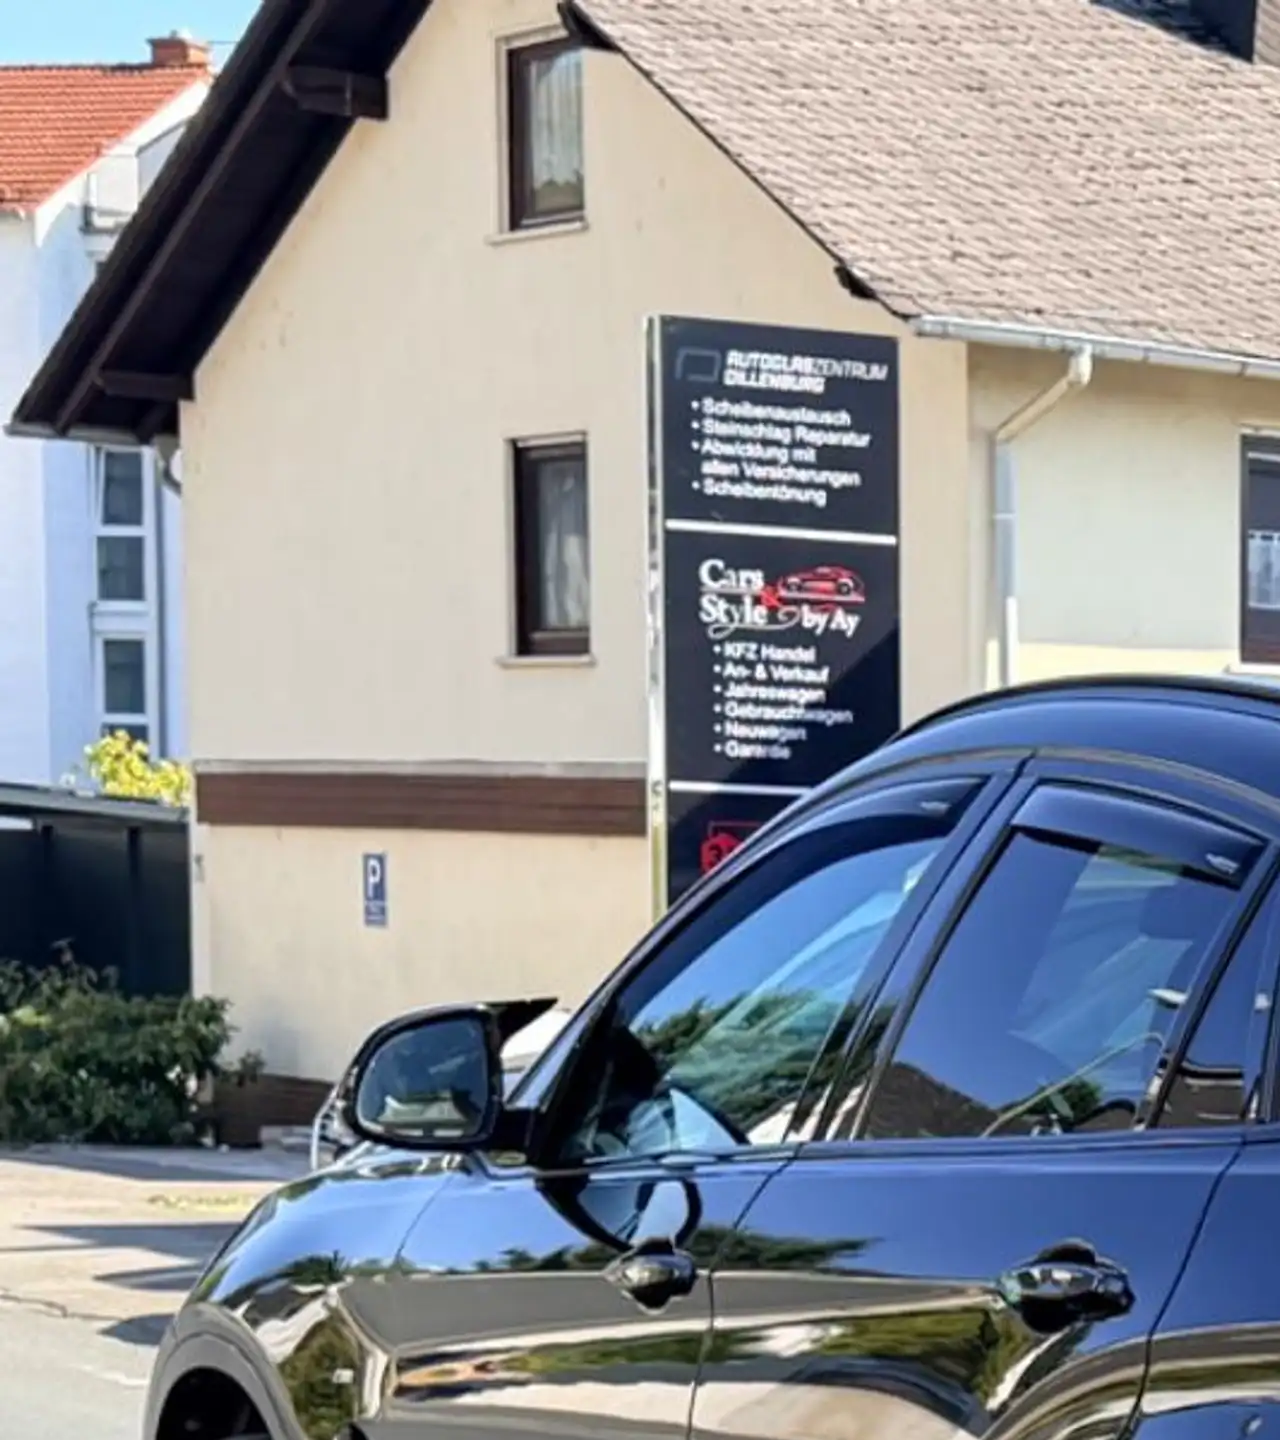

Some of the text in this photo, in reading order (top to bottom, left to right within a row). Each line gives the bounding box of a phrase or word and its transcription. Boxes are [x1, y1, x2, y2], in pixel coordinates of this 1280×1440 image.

[723, 369, 826, 394] DILLENBURG
[702, 397, 851, 426] Scheibenaustausch
[702, 418, 871, 447] Steinschlag Reparatur
[702, 438, 789, 464] Abwicklung
[742, 462, 862, 488] Versicherungen
[699, 559, 764, 590] Cars
[699, 593, 862, 638] Style by Ay
[723, 642, 816, 663] KFZ Handel
[754, 663, 767, 680] &
[769, 664, 830, 683] Verkauf
[723, 681, 826, 705] Jahreswagen
[724, 701, 854, 727] Gebrauchtwagen
[724, 720, 807, 743] Neuwagen
[367, 859, 380, 898] P
